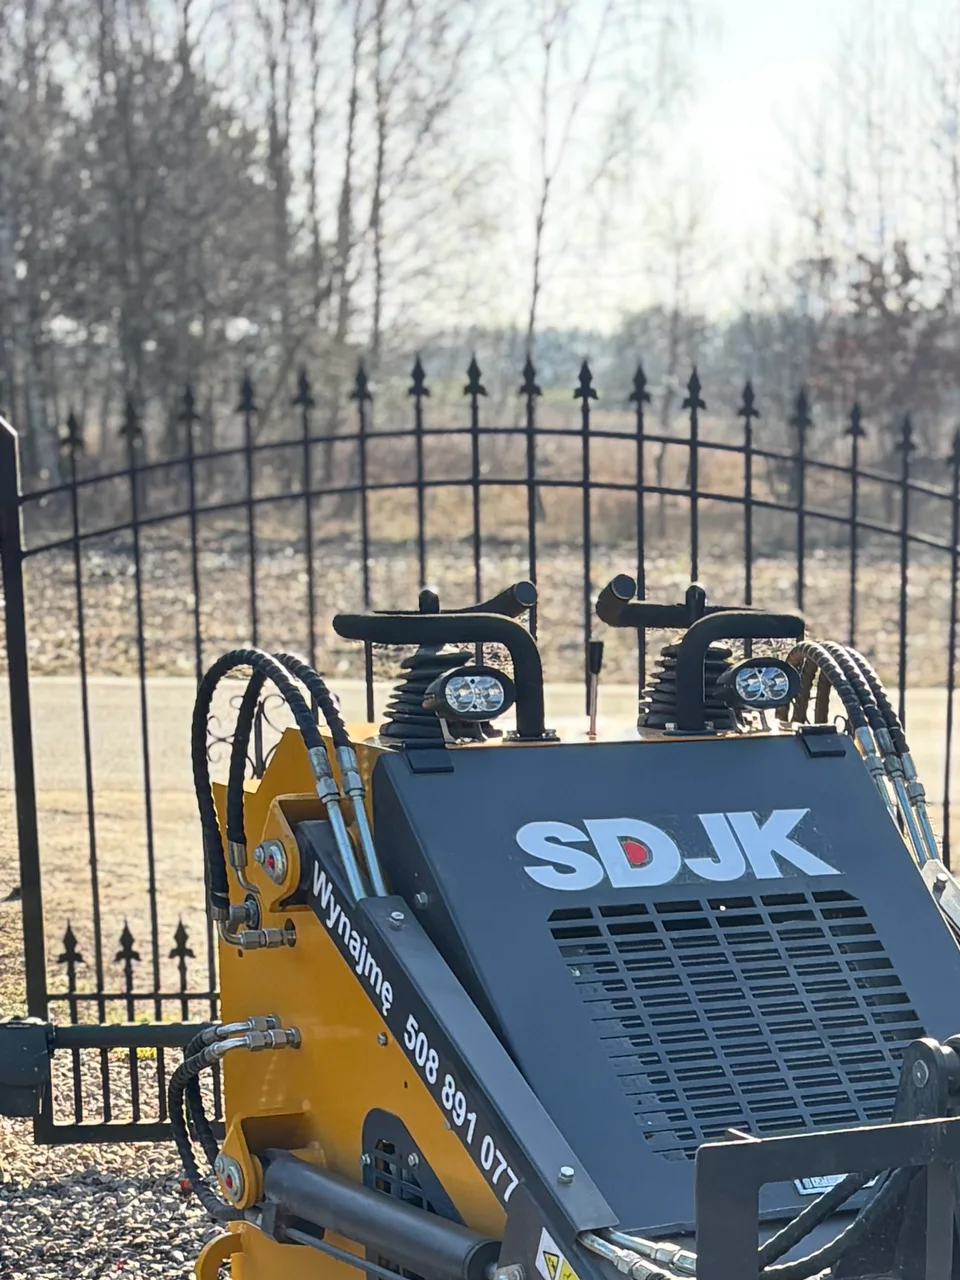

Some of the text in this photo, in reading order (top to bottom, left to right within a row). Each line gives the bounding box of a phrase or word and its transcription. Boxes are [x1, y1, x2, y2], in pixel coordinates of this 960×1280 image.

[516, 808, 842, 891] SDJK
[312, 859, 520, 1203] Wynajmę 508 891 077
